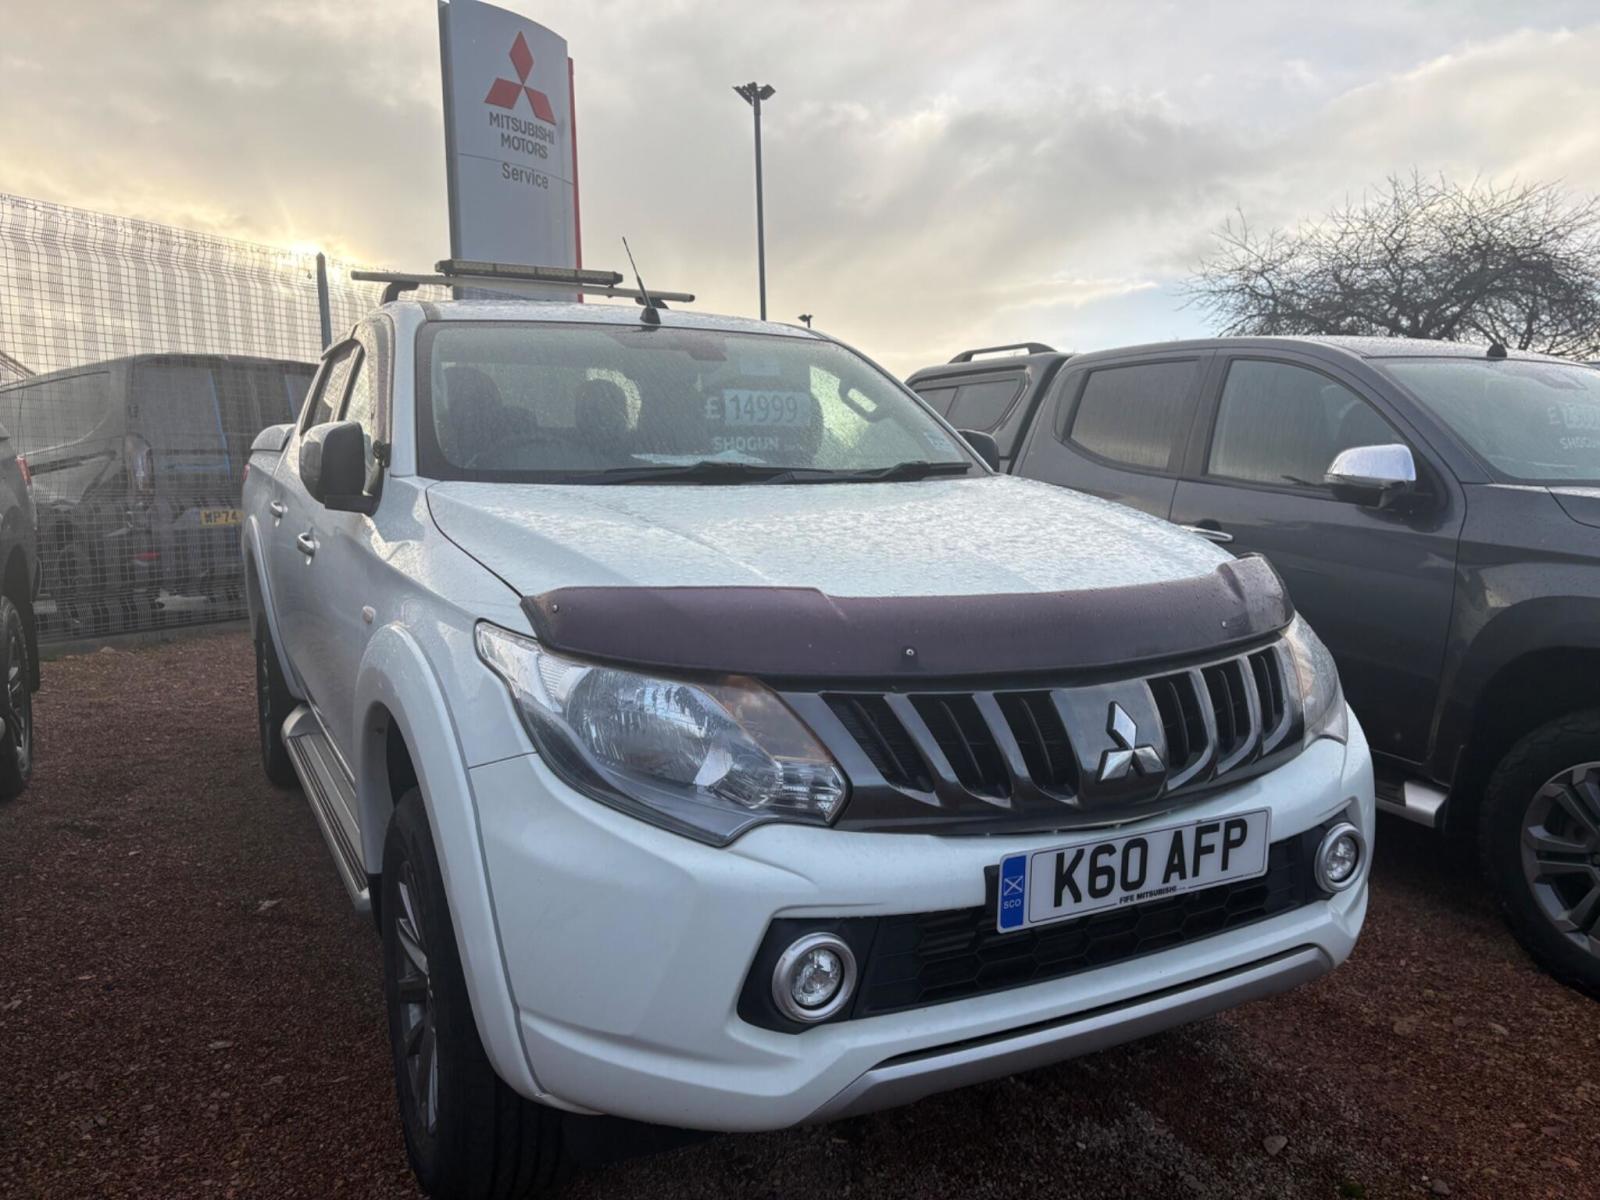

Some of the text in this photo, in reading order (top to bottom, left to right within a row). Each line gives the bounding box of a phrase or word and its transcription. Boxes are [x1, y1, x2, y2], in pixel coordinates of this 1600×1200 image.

[489, 111, 555, 145] MITSUBISHI
[500, 133, 548, 160] MOTORS
[502, 162, 549, 189] Service
[713, 436, 780, 452] SHOGUN
[1053, 818, 1248, 908] K60 AFP
[1003, 899, 1022, 909] SCO
[1136, 885, 1177, 900] MITSUBISHI
